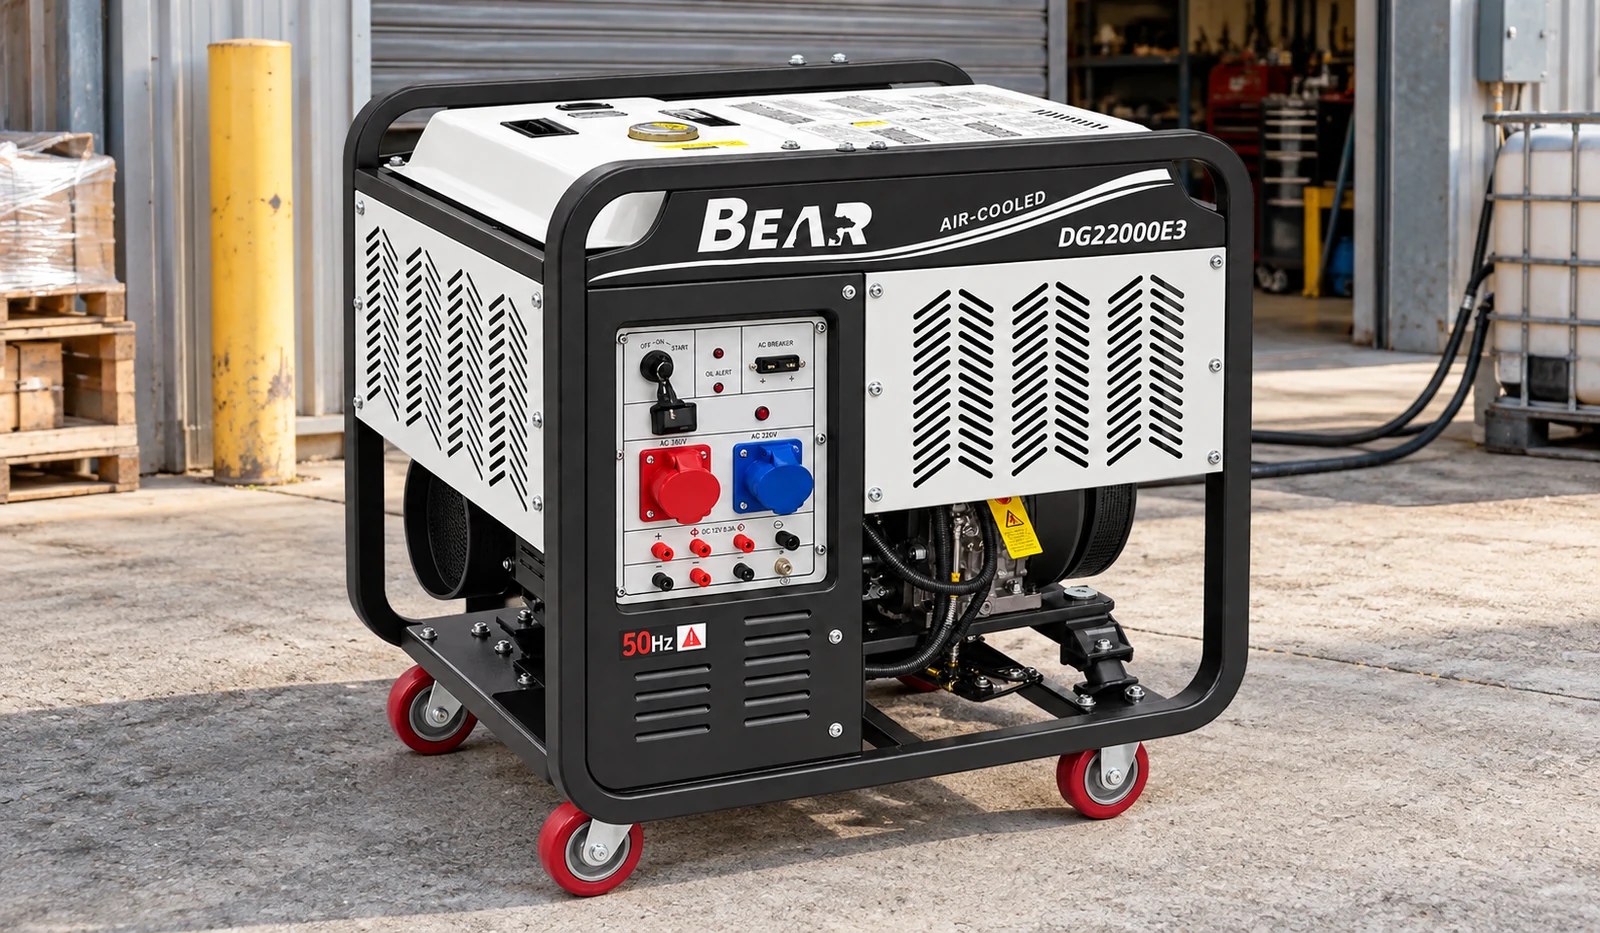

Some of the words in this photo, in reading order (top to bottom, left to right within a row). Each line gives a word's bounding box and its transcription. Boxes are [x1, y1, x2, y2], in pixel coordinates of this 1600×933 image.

[939, 190, 1046, 233] AIR-COOLED
[697, 197, 873, 253] BEAR
[1057, 219, 1188, 249] DG22000E3
[640, 342, 651, 350] OFF
[767, 339, 794, 348] BREAKER
[715, 368, 732, 376] ALERT
[761, 431, 778, 439] 220V
[660, 439, 670, 447] AC
[622, 630, 674, 657] 50Hz
